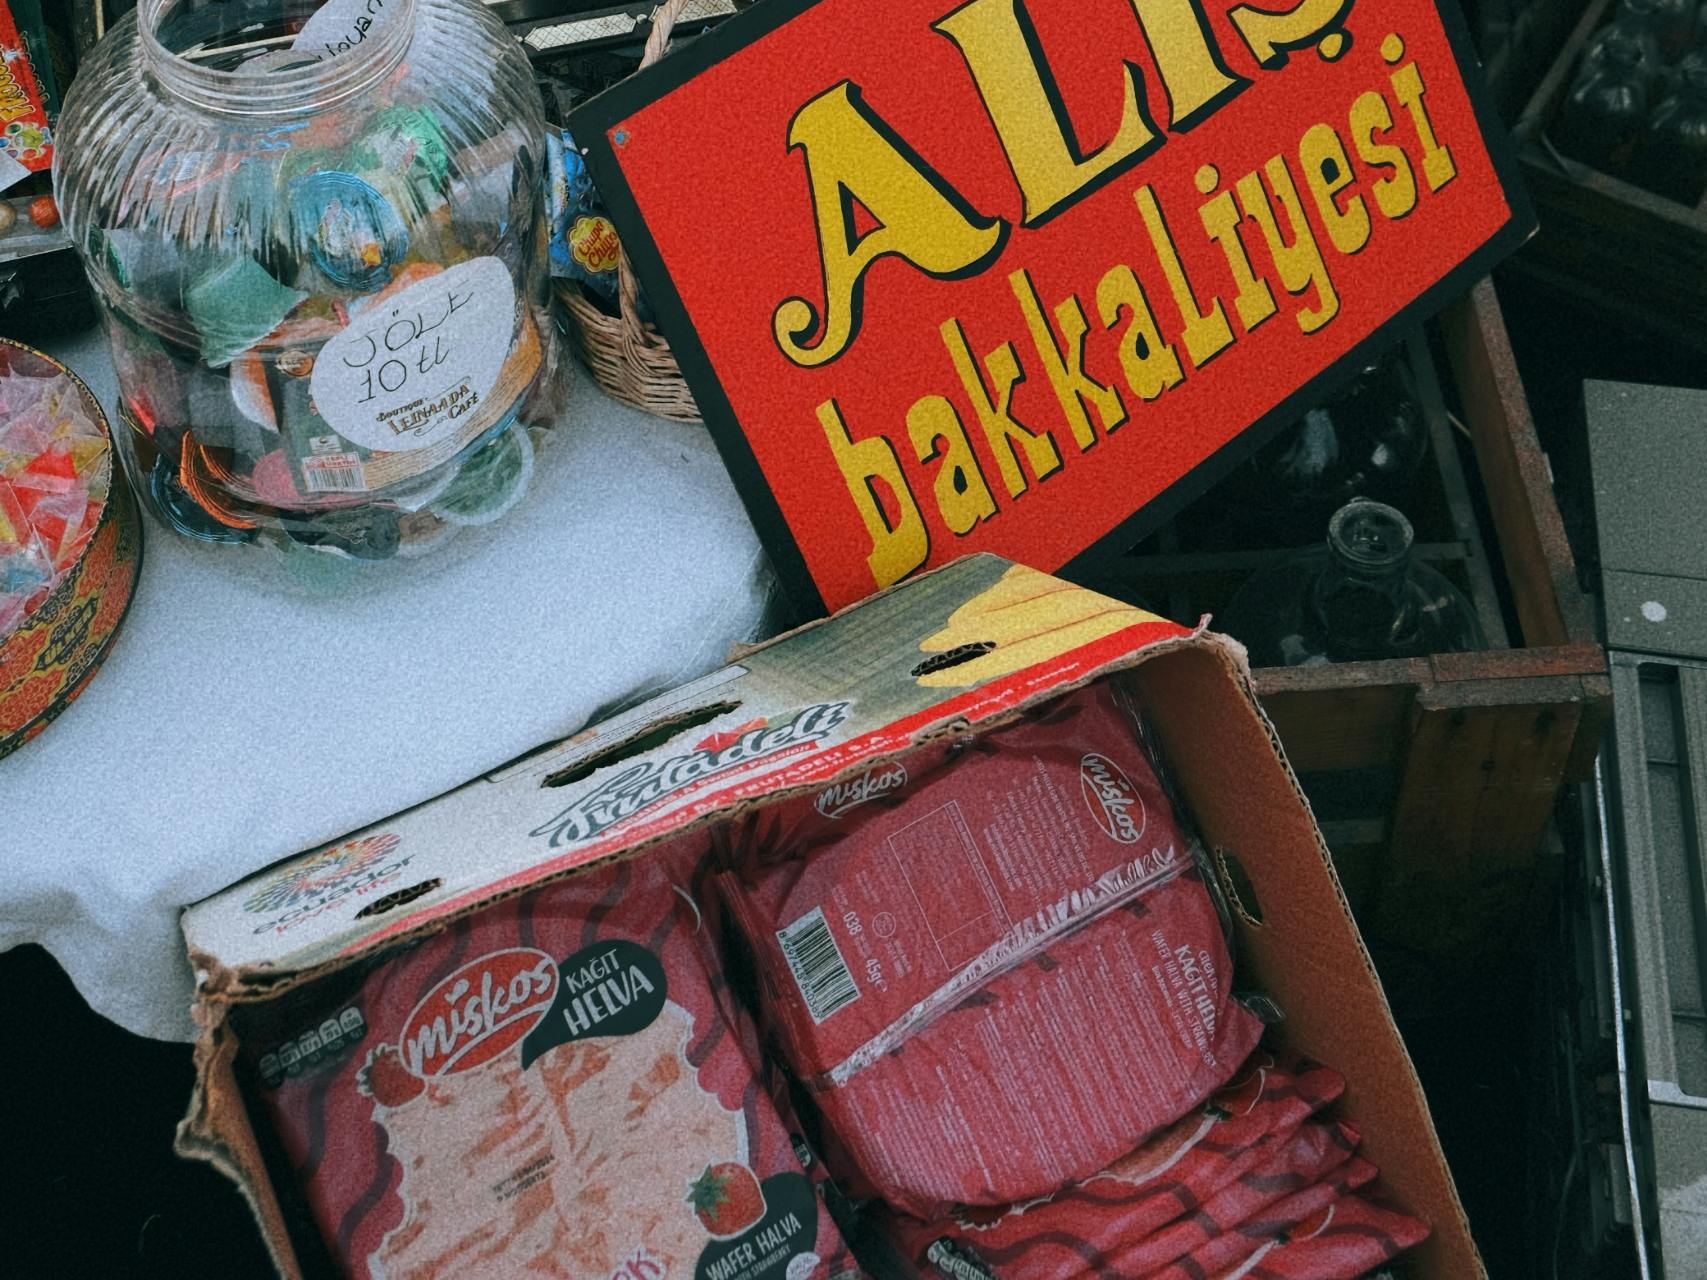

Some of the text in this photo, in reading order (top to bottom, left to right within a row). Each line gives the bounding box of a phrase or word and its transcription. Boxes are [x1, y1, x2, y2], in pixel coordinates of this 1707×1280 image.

[358, 359, 407, 404] 10
[253, 854, 415, 934] ecuador
[843, 911, 863, 936] 038
[565, 948, 621, 994] KAĞIT
[408, 957, 552, 1075] miskos
[562, 964, 655, 1036] HELVA
[755, 1211, 802, 1255] HALVA
[705, 1242, 757, 1280] WAFER
